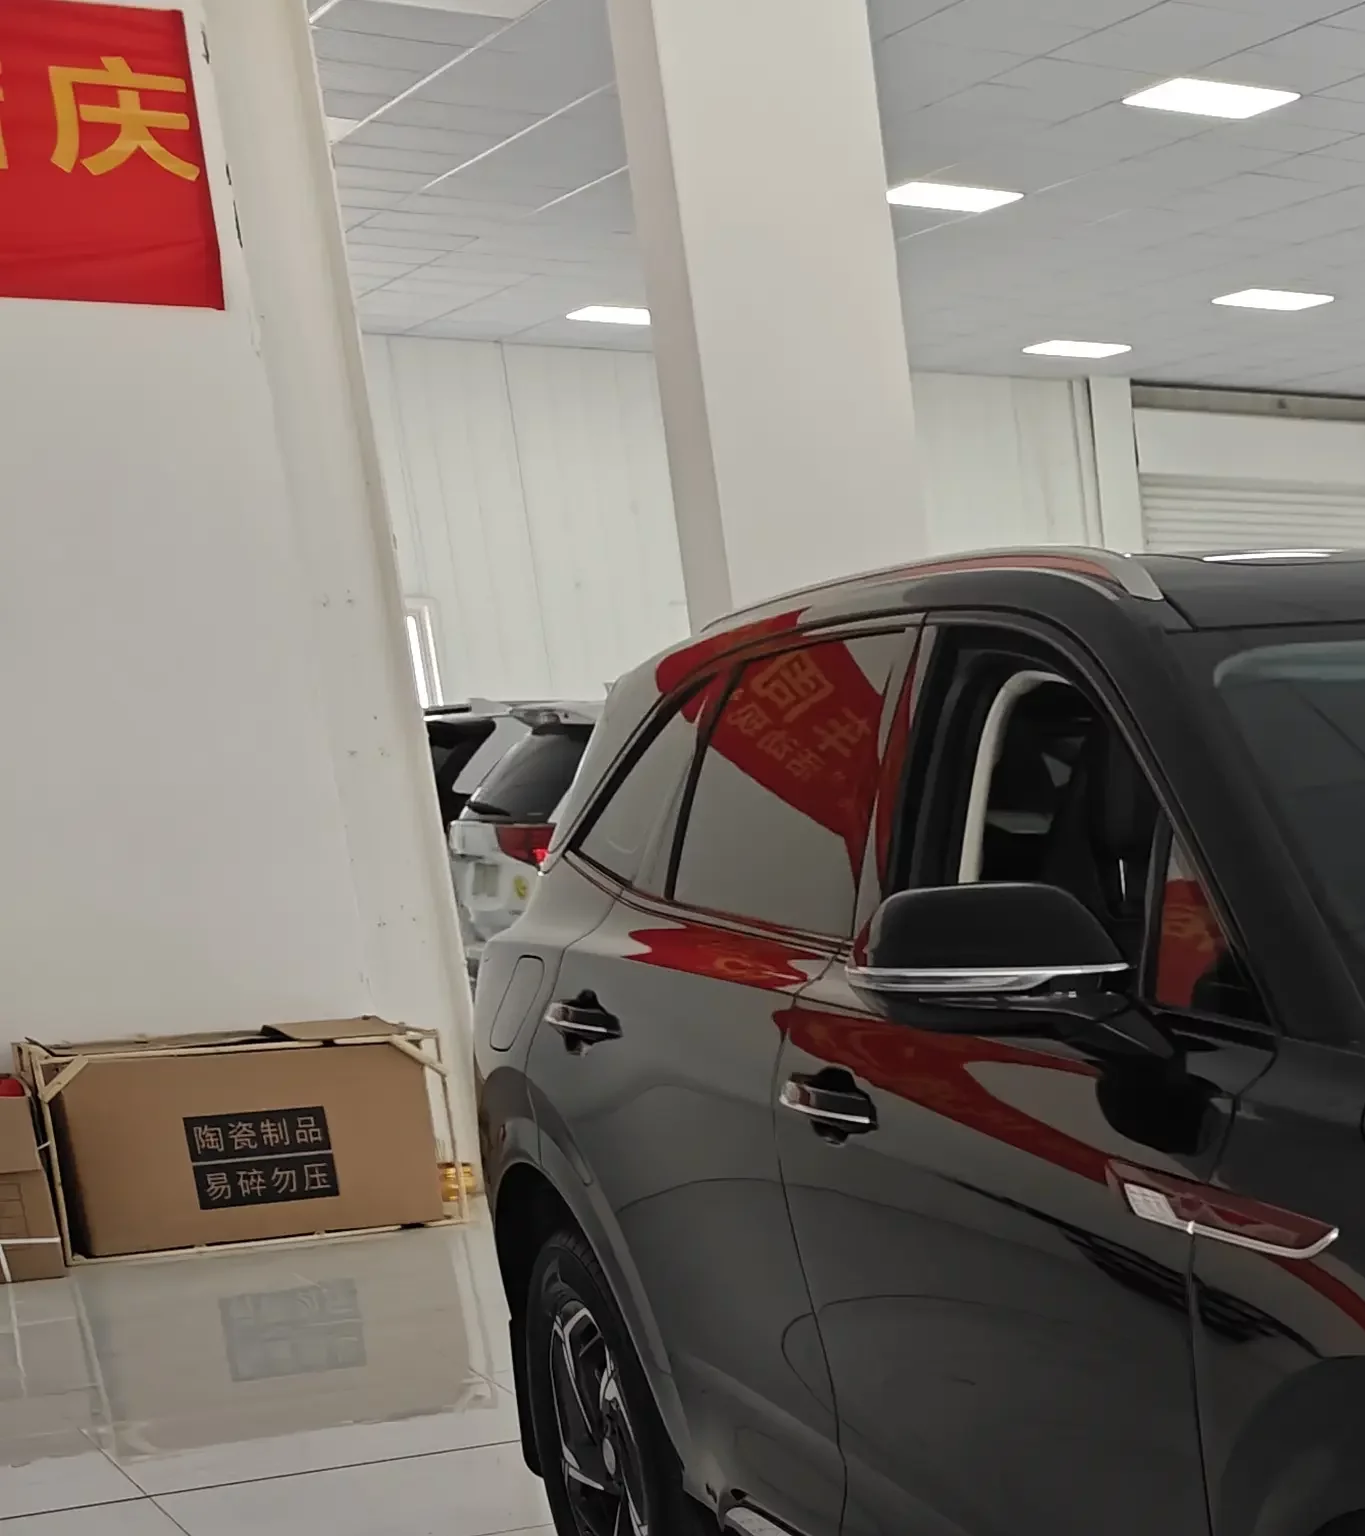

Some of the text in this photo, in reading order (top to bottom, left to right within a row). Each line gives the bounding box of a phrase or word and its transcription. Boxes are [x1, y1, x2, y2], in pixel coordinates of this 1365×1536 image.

[0, 56, 200, 181] 庆
[193, 1116, 322, 1155] 陶瓷制品
[206, 1162, 331, 1200] 易碎勿压
